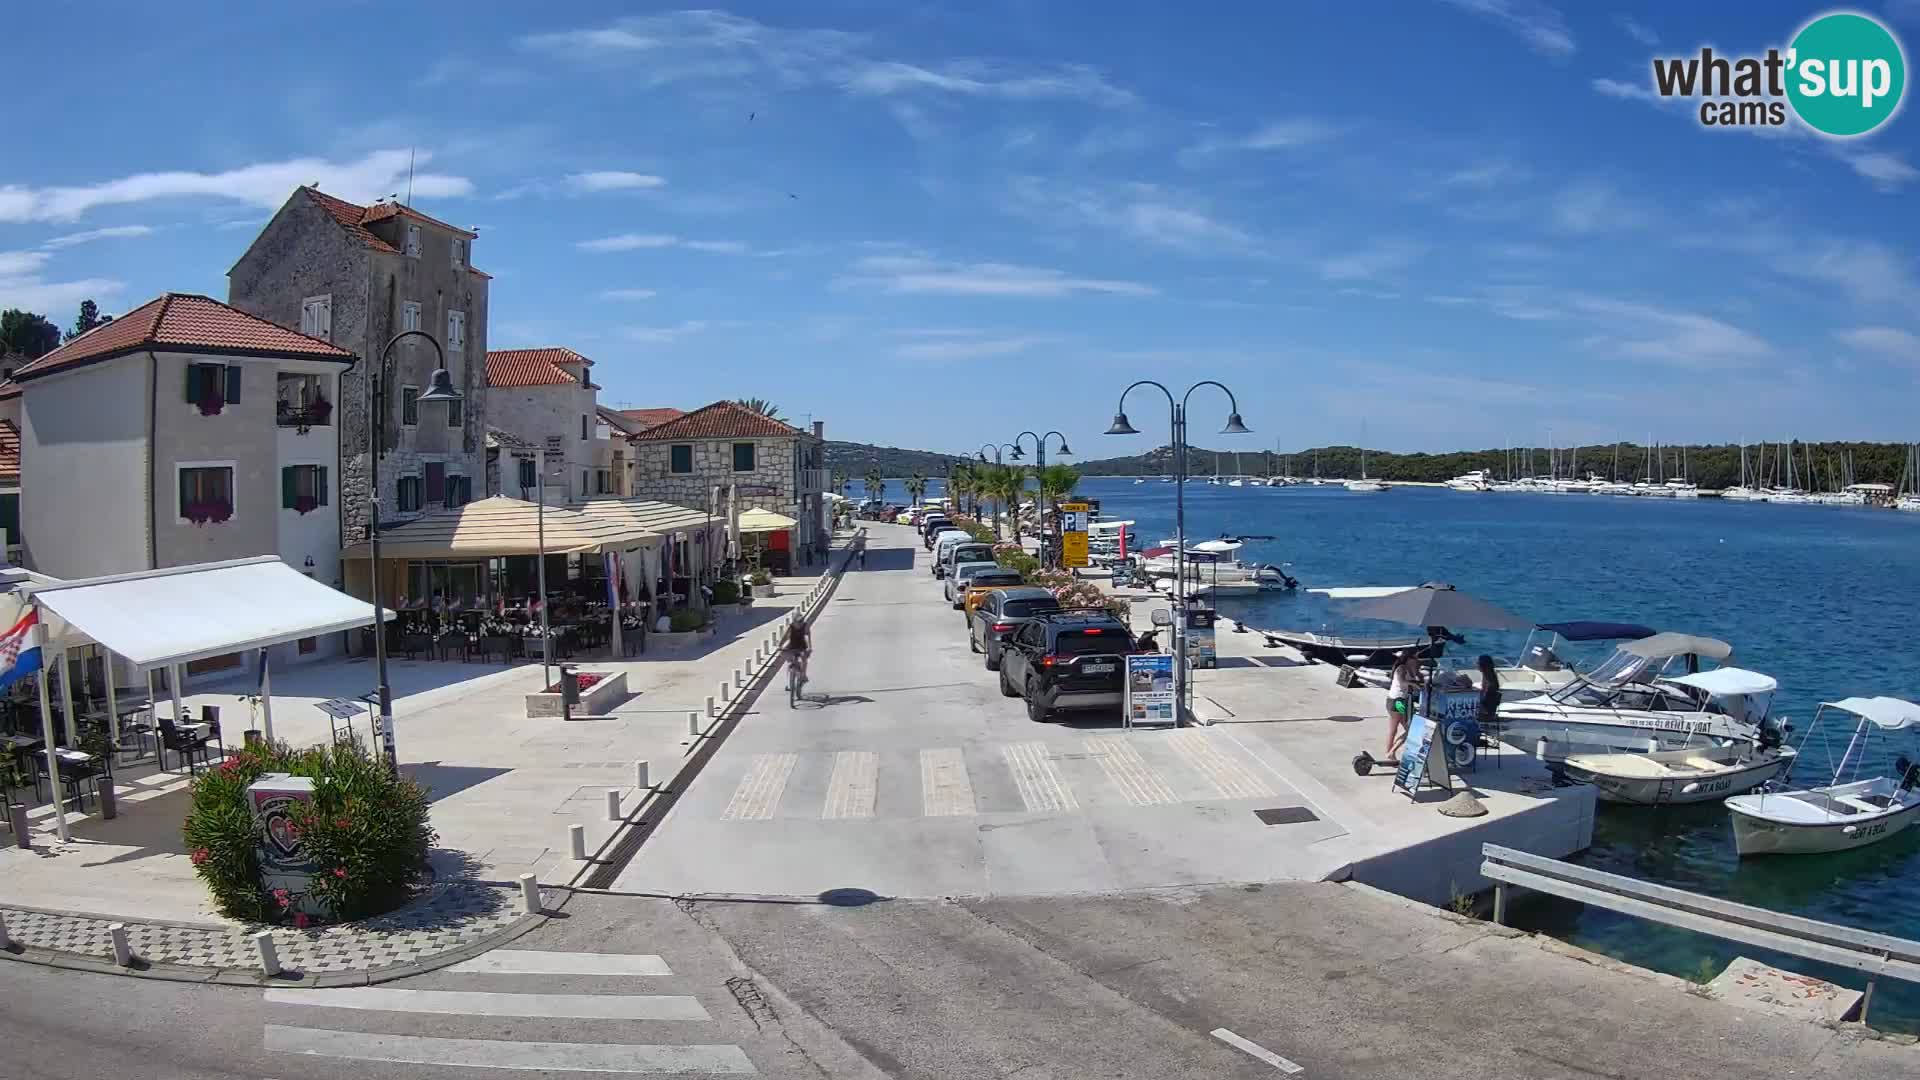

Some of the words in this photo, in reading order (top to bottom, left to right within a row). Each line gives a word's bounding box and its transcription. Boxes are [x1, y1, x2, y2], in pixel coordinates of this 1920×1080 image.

[1447, 697, 1477, 709] RENT
[1446, 710, 1453, 719] A
[1455, 709, 1477, 719] BOAT
[1665, 720, 1684, 730] RENT
